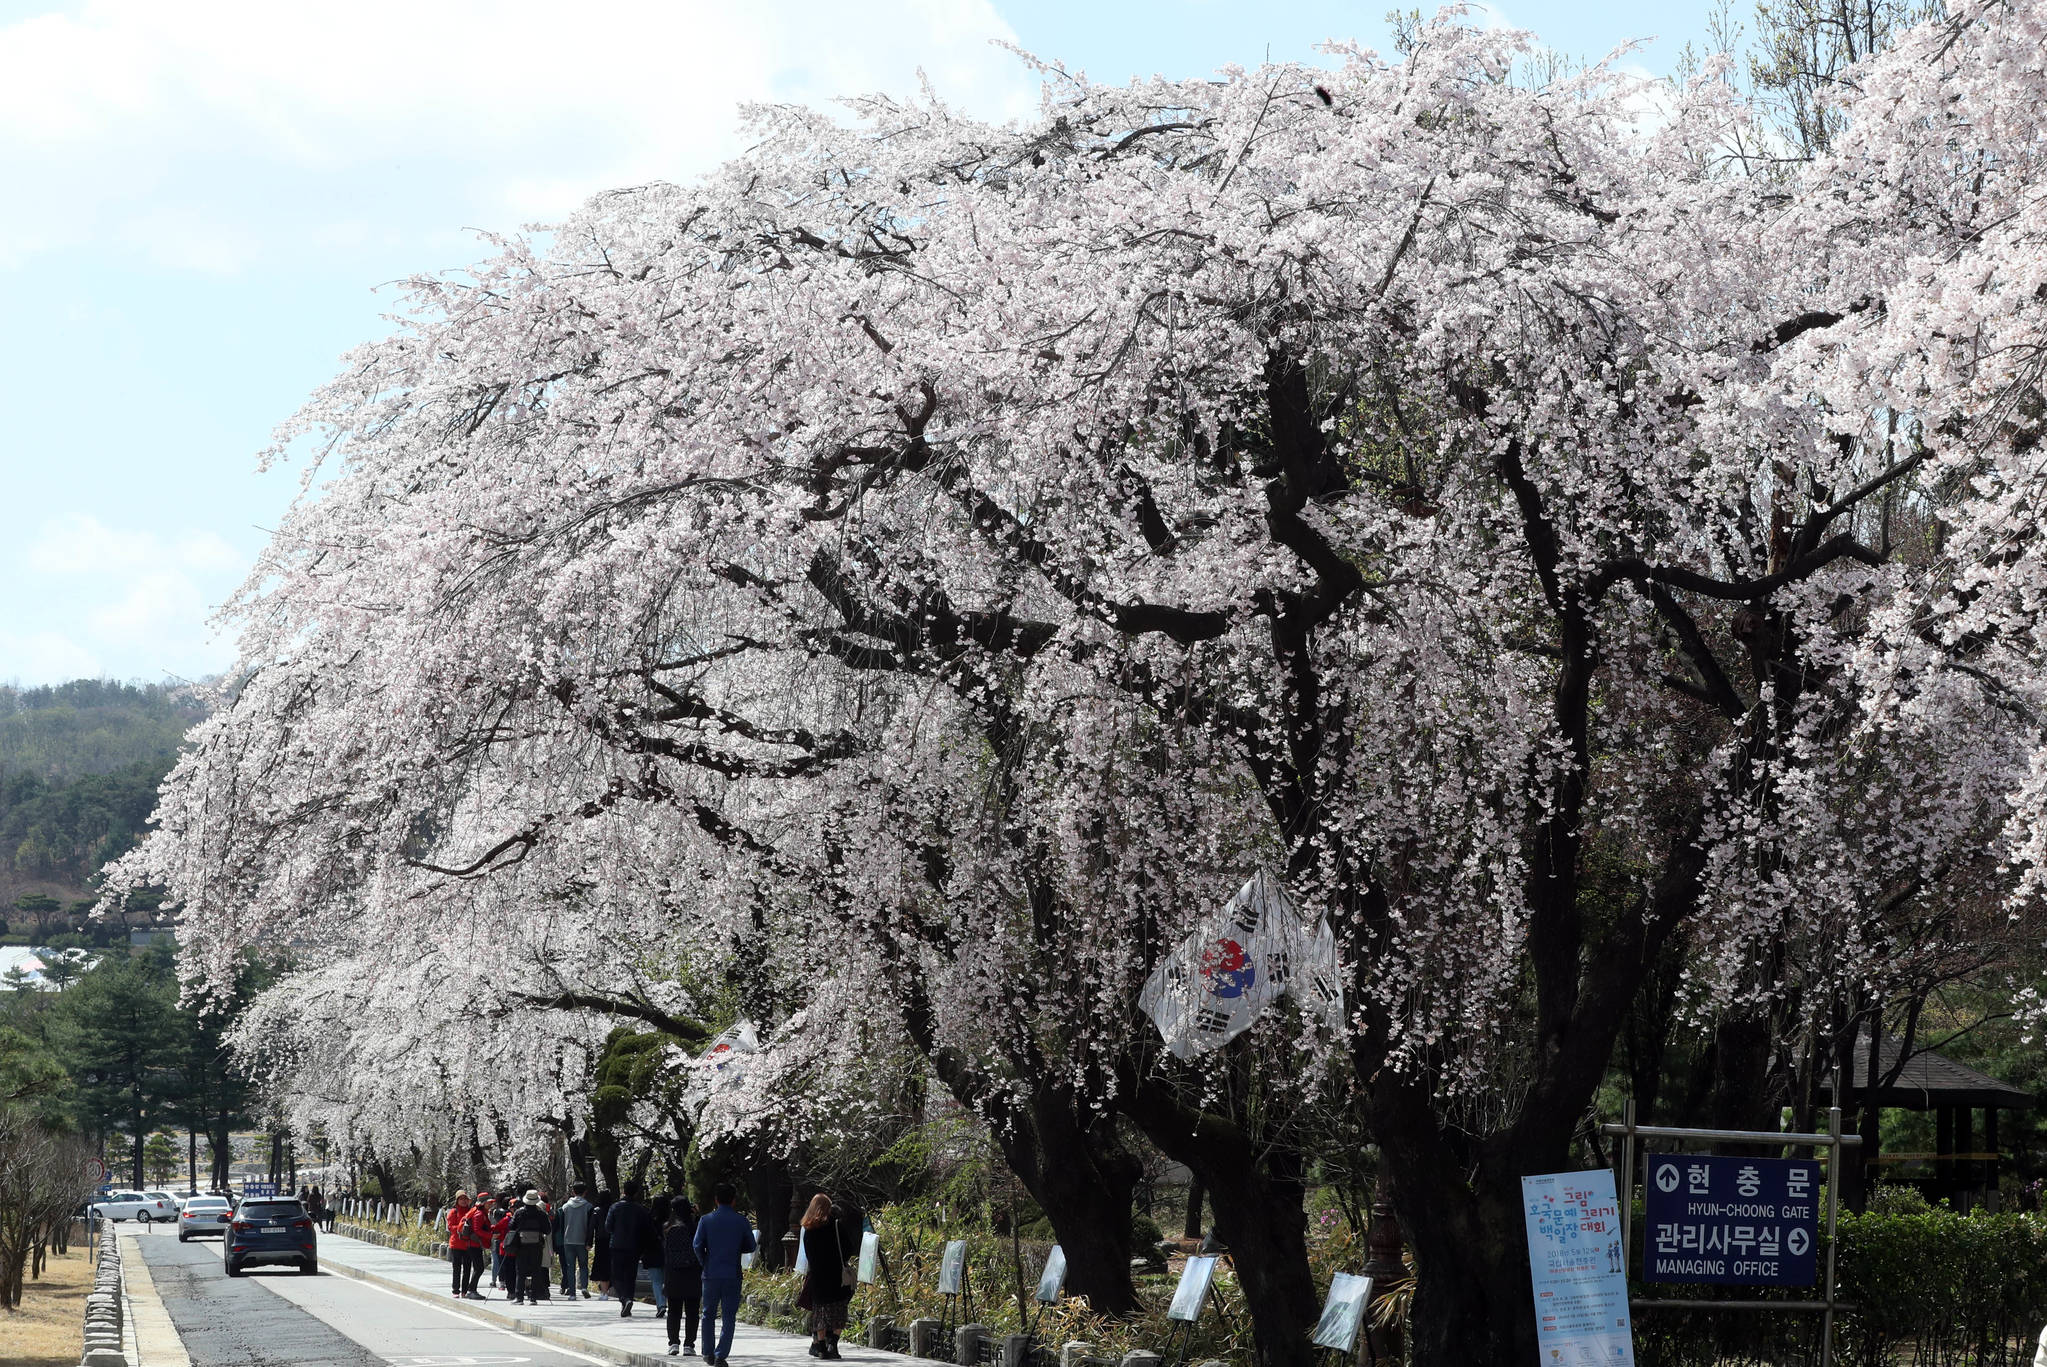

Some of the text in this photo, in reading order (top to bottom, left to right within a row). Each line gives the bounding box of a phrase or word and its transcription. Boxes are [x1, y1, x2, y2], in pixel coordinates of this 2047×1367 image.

[1580, 1207, 1615, 1221] 그리기
[1688, 1203, 1810, 1219] HYUN-CHOONG GATE
[1539, 1221, 1606, 1244] 백일장 대회
[1655, 1223, 1780, 1257] 관리사무실
[1656, 1259, 1779, 1276] MANAGING OFFICE
